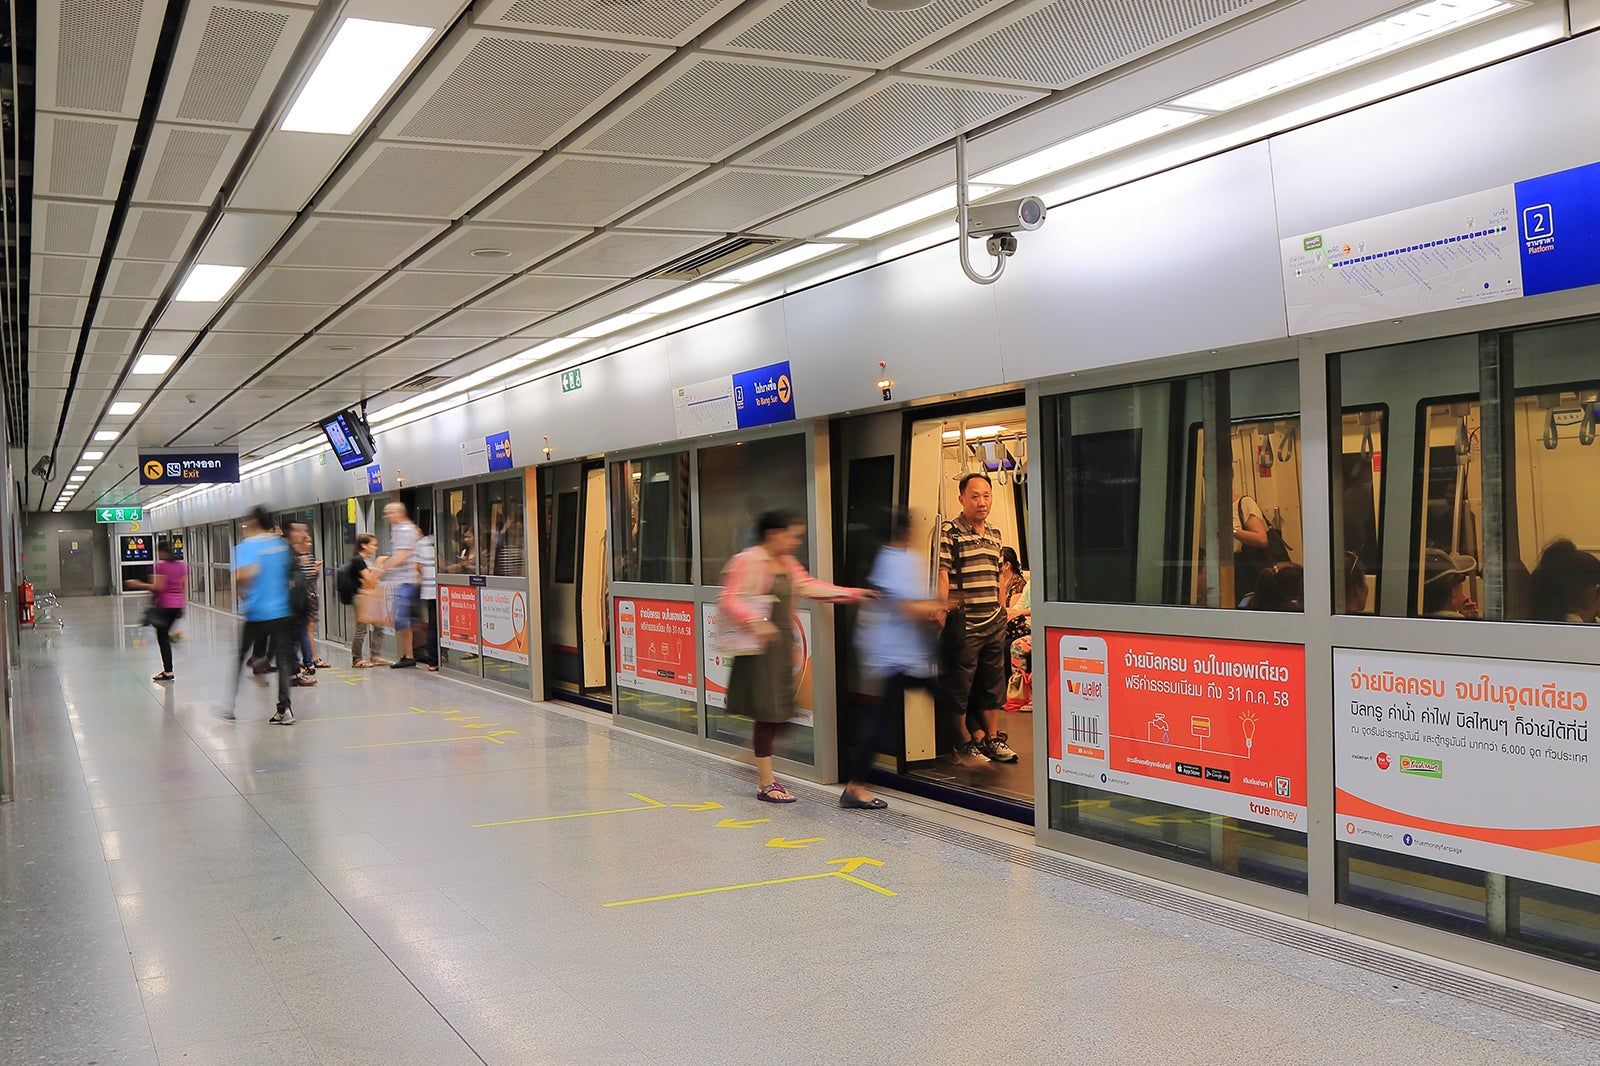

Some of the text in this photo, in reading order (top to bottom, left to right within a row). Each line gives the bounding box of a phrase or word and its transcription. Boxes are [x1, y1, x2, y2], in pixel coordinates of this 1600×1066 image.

[1533, 213, 1545, 232] 2
[1528, 244, 1555, 255] Platform
[182, 459, 221, 469] ทางออก
[183, 470, 200, 478] Exit
[1124, 649, 1289, 683] จ่ายบิลครบ จบในแอพเดียว
[1125, 674, 1289, 708] ฟรีค่าธรรมเนียม ถึง 31 ก.ค. 58
[1351, 667, 1588, 711] จ่ายบิลครบ จบในจุดเดียว
[1351, 701, 1588, 742] บิลทรู ค่าน้ำ ค่าไฟ บิลไหนๆ ก็จ่ายได้ที่นี่
[1470, 741, 1498, 752] มากกว่า
[1502, 744, 1526, 756] 6,000
[1530, 748, 1541, 759] จุด
[1545, 746, 1588, 763] ทั่วประเทศ
